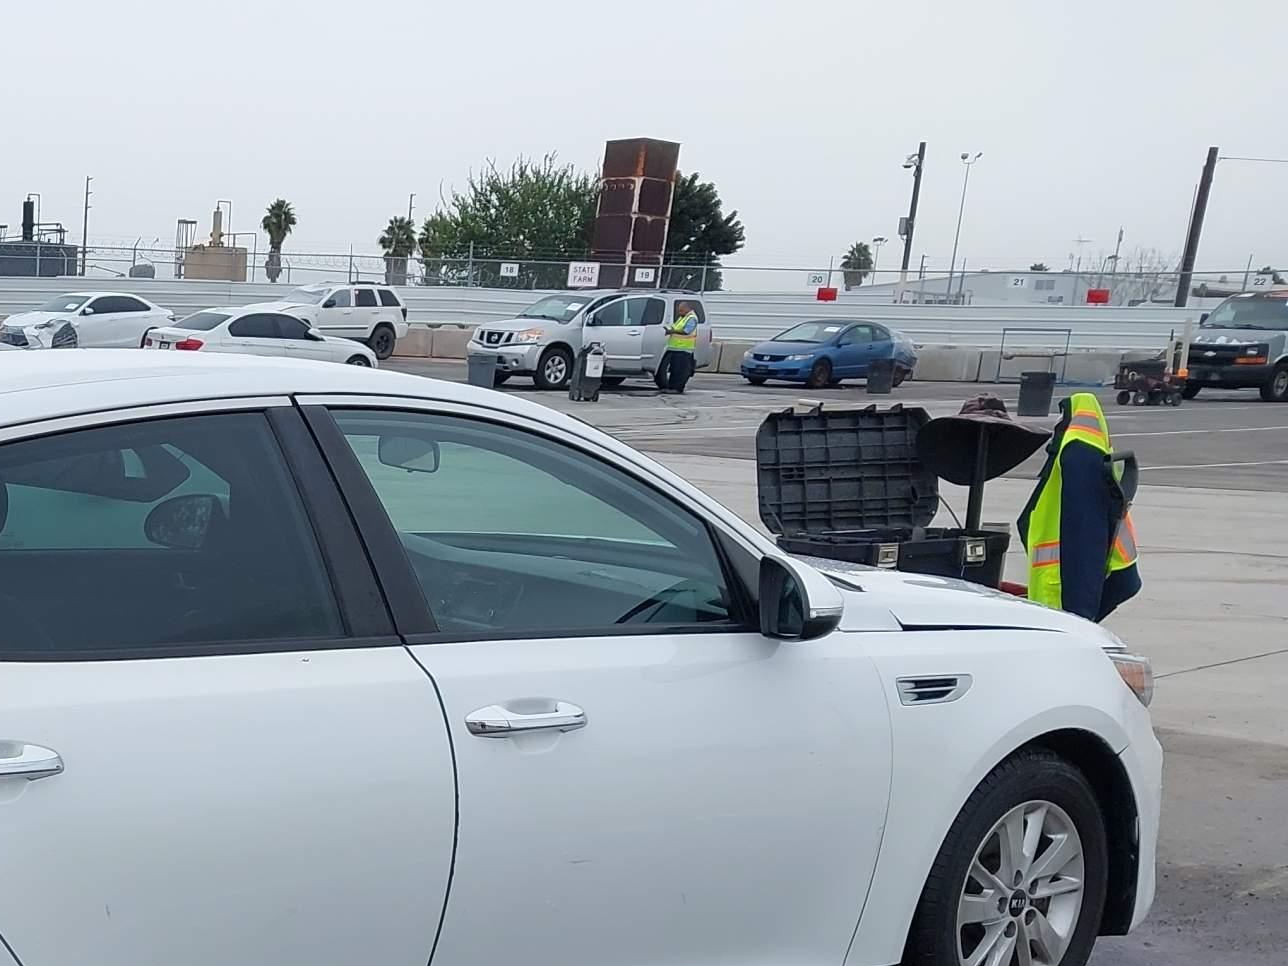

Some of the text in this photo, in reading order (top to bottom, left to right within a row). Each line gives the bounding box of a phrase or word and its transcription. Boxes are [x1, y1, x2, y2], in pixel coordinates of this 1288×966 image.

[573, 266, 595, 274] STATE
[572, 275, 593, 283] FARM
[640, 271, 650, 279] 19
[812, 275, 823, 283] 20
[1013, 278, 1024, 286] 21
